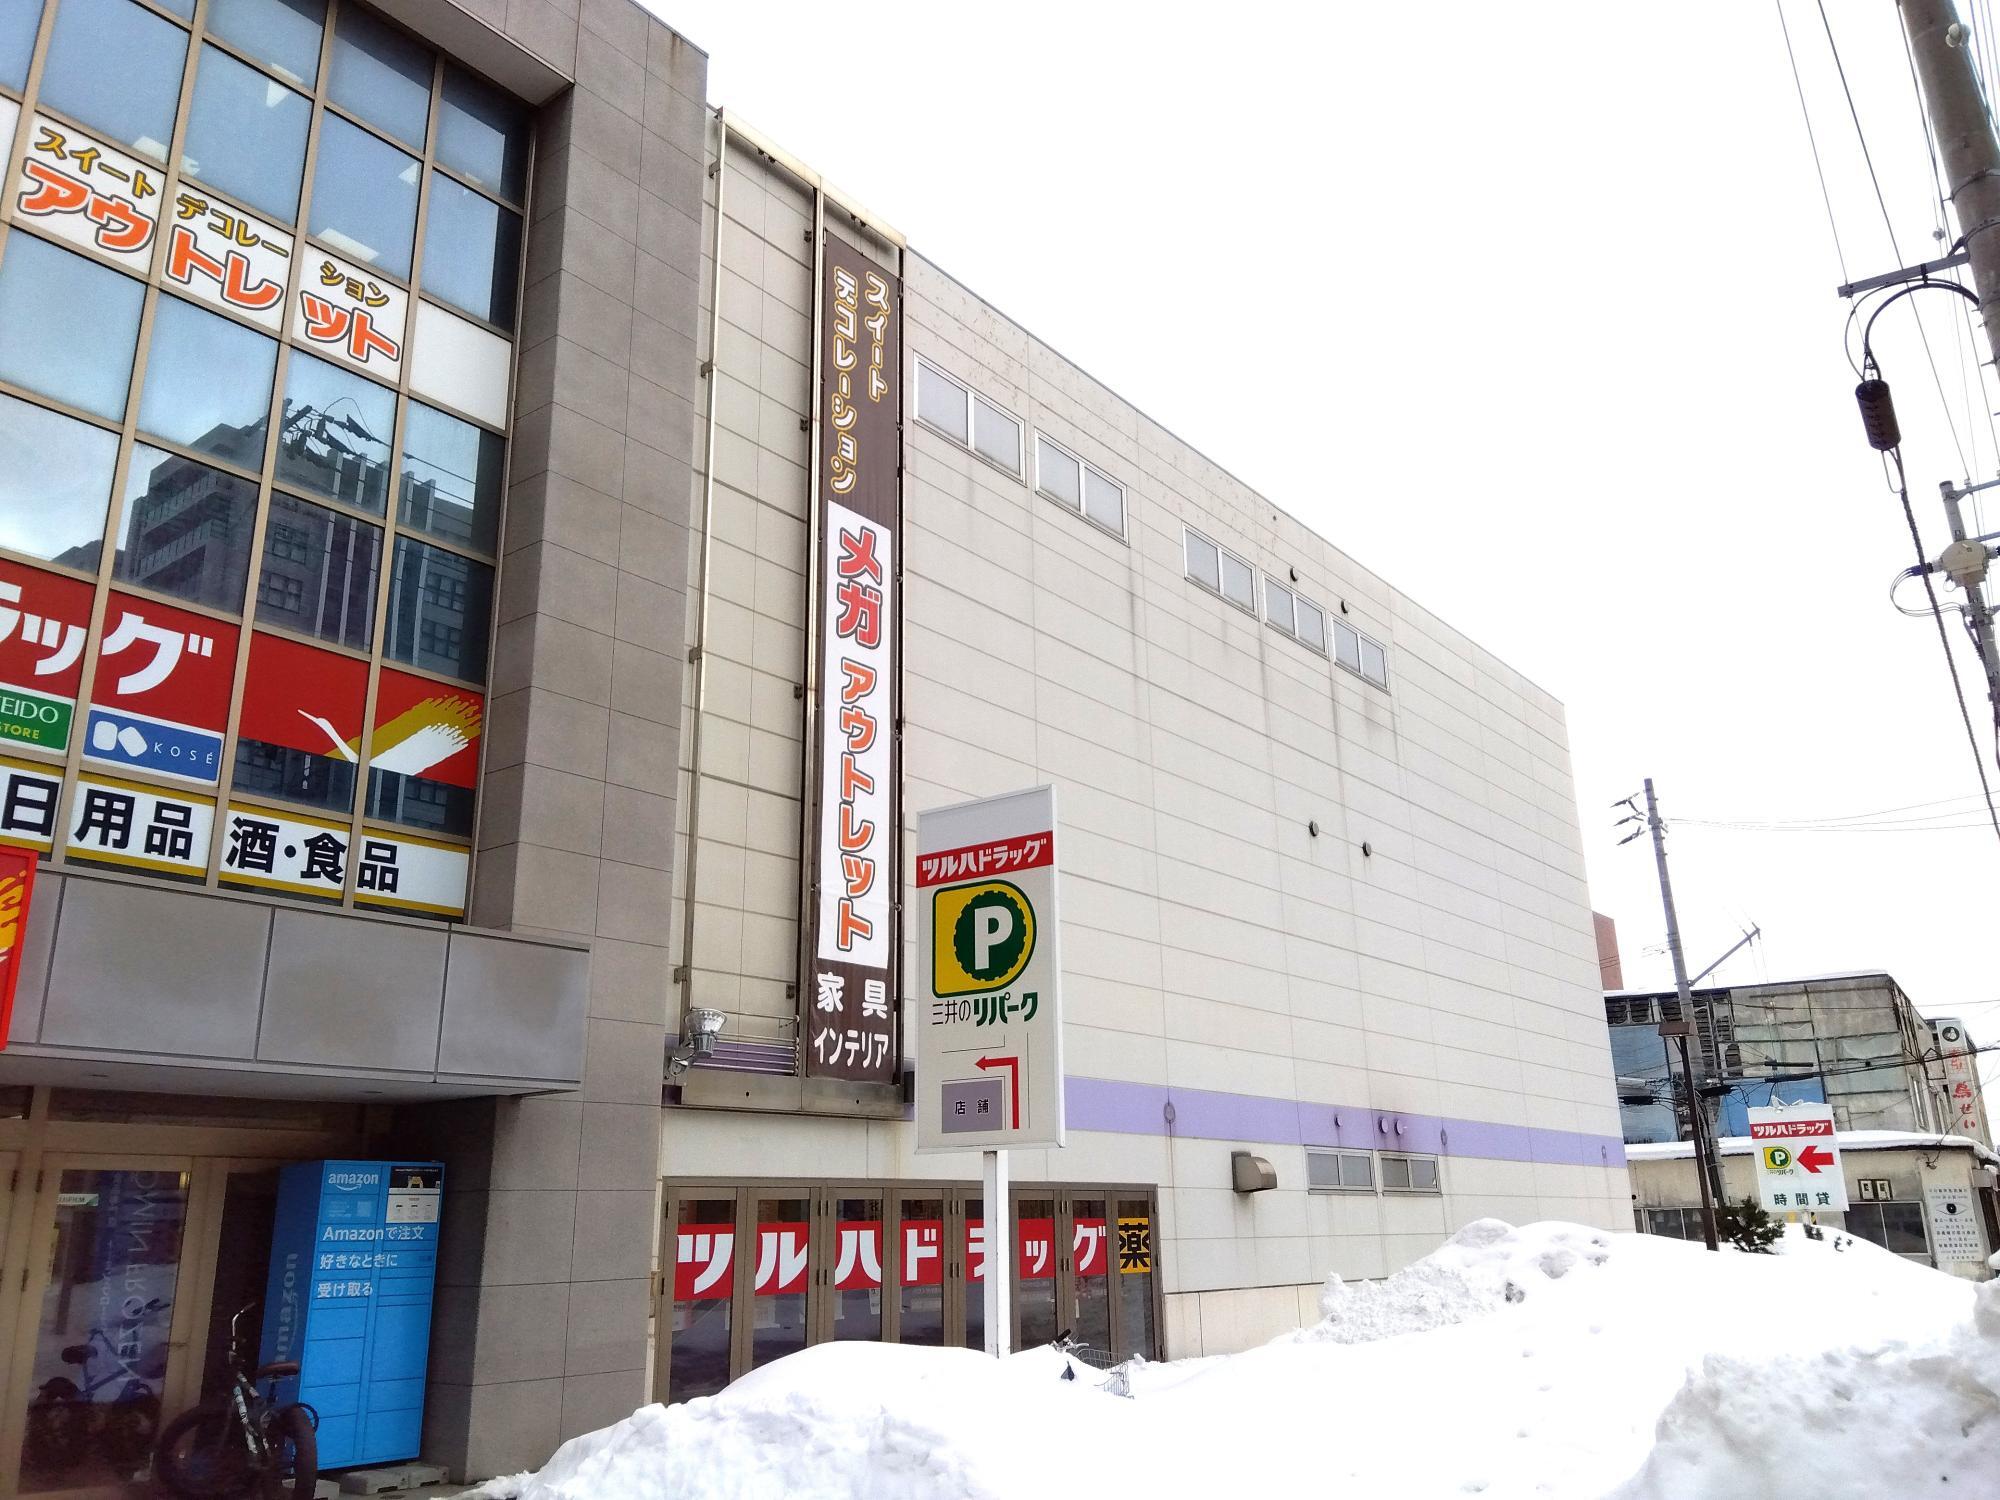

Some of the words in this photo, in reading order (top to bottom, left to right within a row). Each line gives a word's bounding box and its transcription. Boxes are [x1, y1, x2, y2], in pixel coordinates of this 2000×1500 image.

[865, 271, 891, 403] スイート
[831, 265, 858, 494] デコレーション
[836, 525, 882, 650] メガ
[0, 581, 214, 695] ッグ
[0, 695, 59, 724] EIDO
[0, 721, 40, 740] TORE
[154, 741, 213, 765] KOSÉ
[836, 656, 878, 953] アウトレット
[922, 837, 1047, 880] ツルハドラッグ
[975, 904, 1013, 970] P
[817, 971, 888, 1019] 家具
[814, 1026, 889, 1069] インテリア
[954, 1098, 989, 1116] 店舗
[1753, 1122, 1829, 1137] ツルハドラッグ
[1774, 1151, 1786, 1165] P
[328, 1173, 379, 1185] amazon
[1773, 1192, 1831, 1206] 時間貸
[323, 1225, 425, 1241] Amazonで注文
[1118, 1223, 1150, 1269] 薬
[319, 1254, 398, 1270] 好きなときに
[317, 1282, 373, 1298] 受け取る
